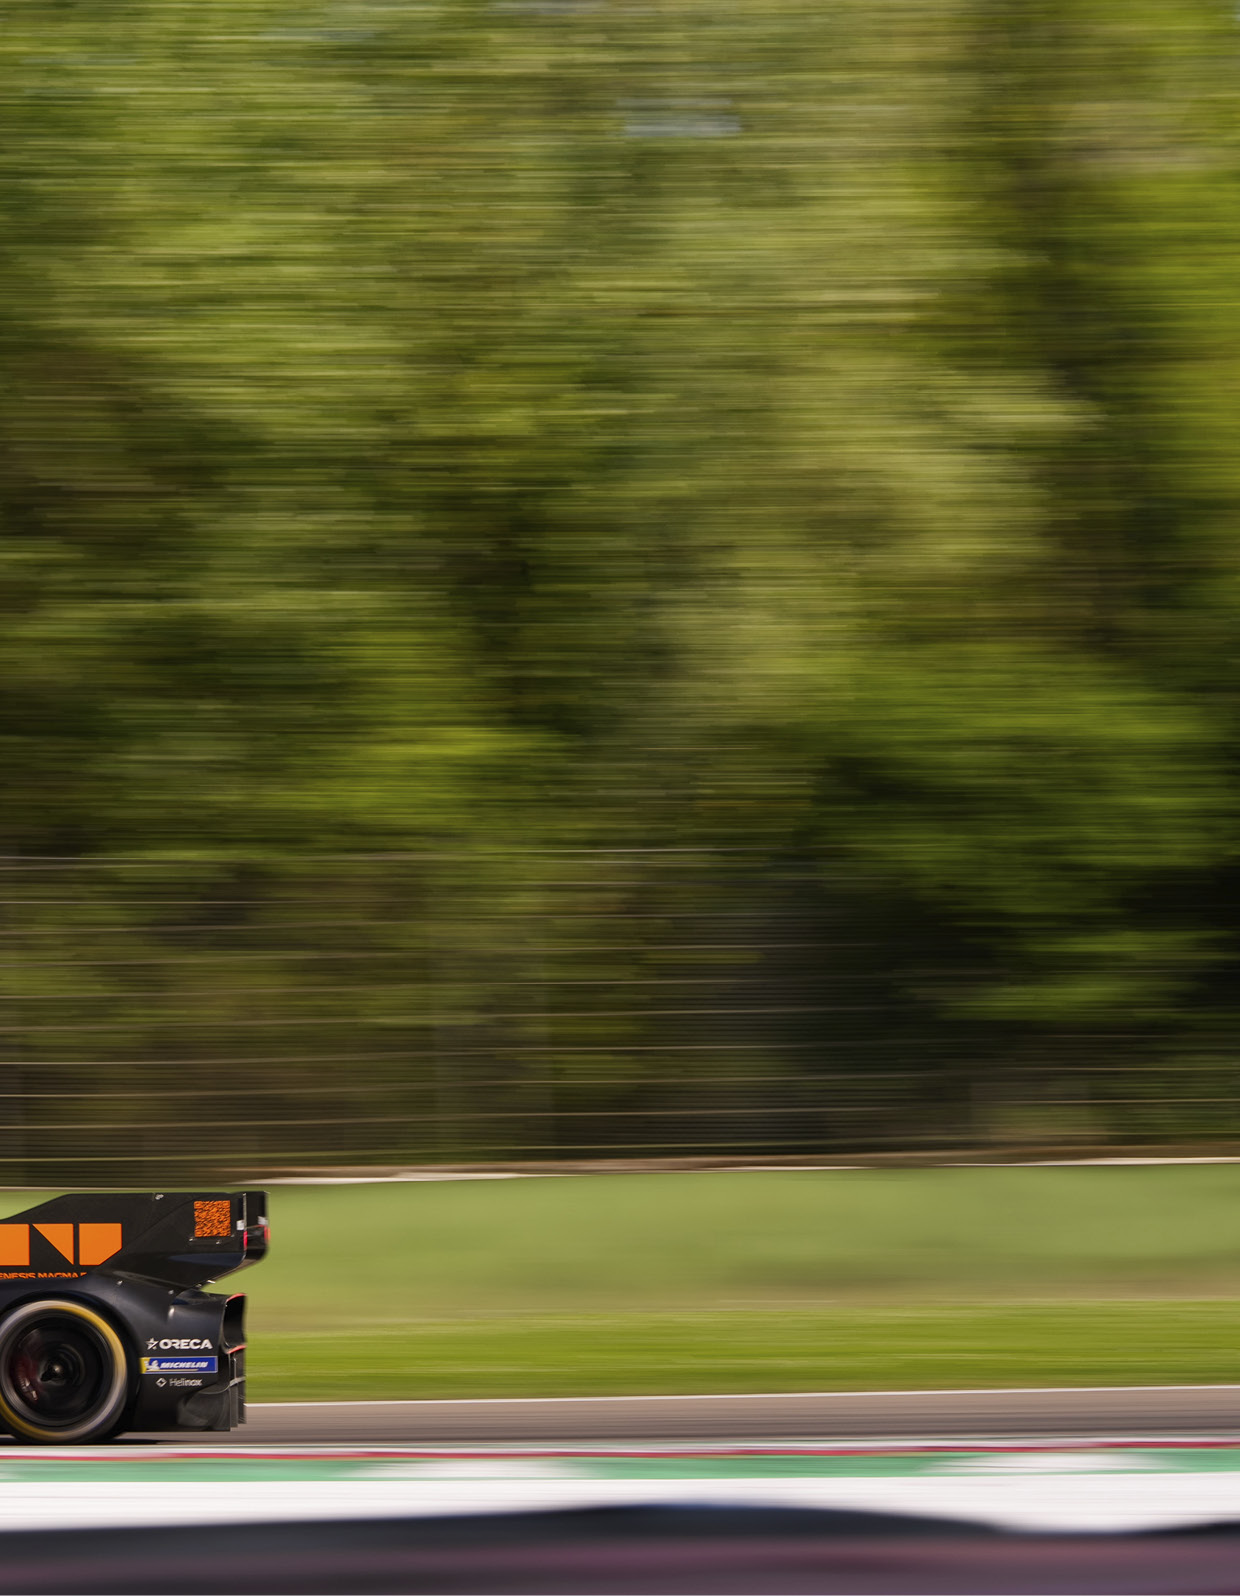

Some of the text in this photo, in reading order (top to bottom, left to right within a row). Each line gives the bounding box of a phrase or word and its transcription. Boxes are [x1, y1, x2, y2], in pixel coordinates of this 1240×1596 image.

[158, 1338, 213, 1350] ORECA
[160, 1361, 209, 1369] MICHELIN
[169, 1377, 202, 1386] Helinox
